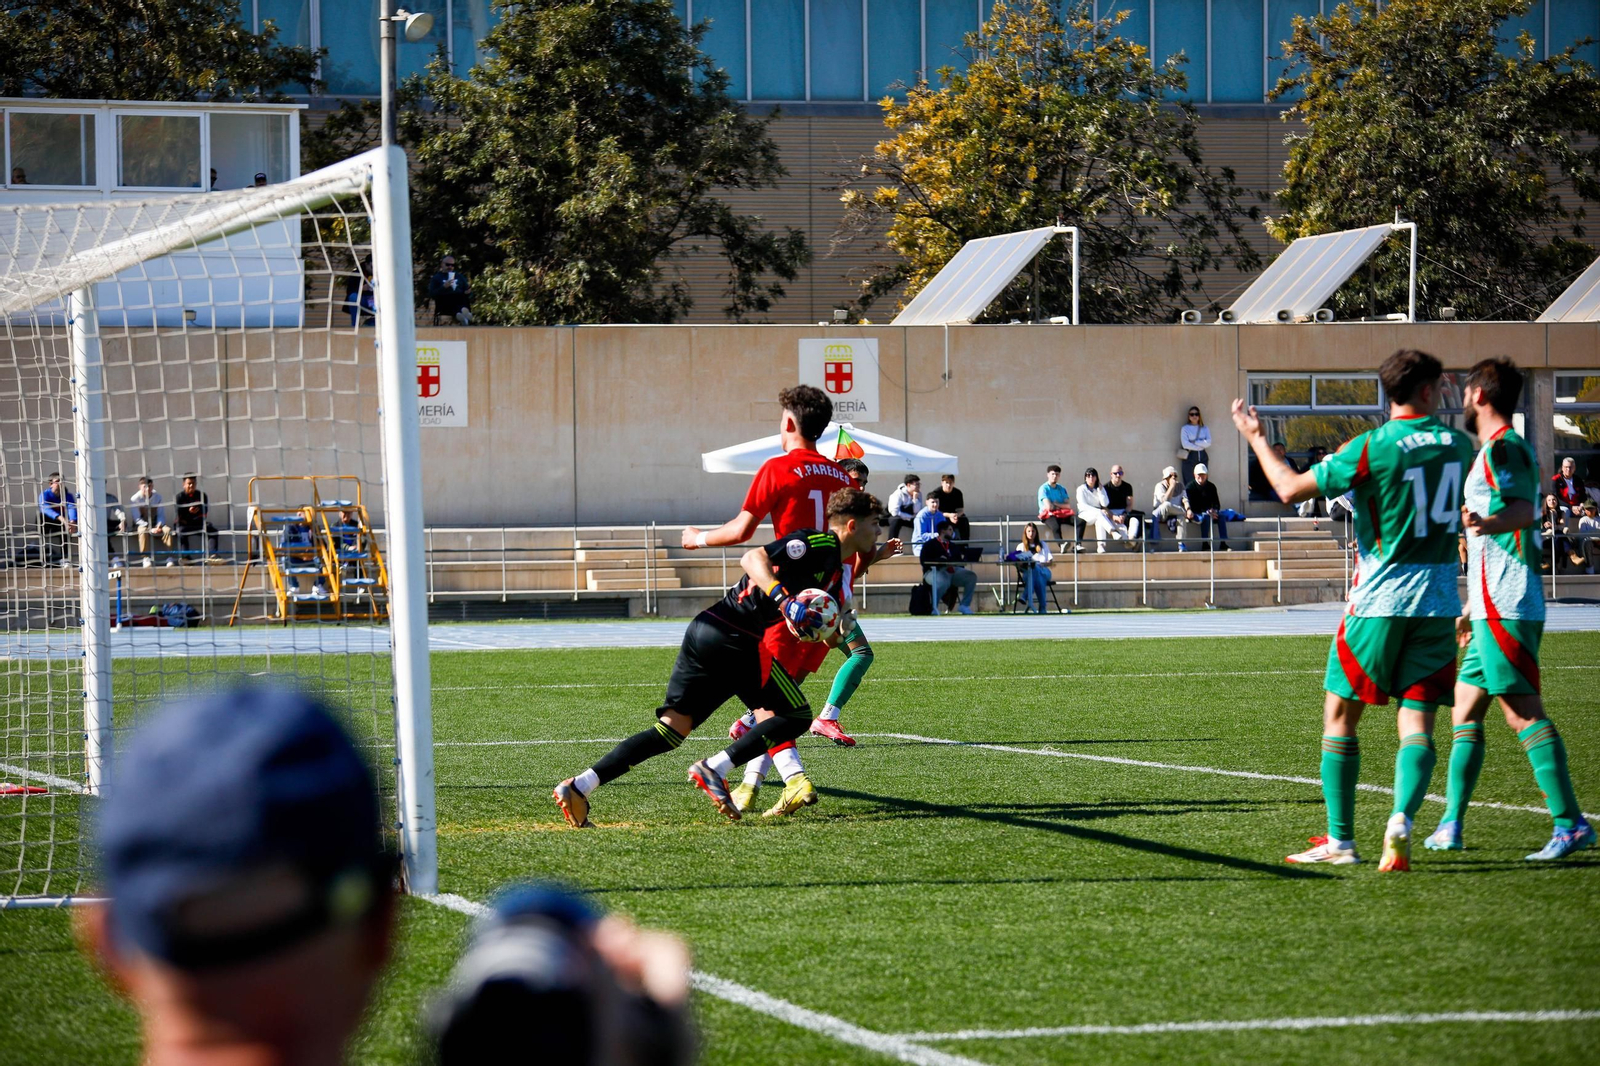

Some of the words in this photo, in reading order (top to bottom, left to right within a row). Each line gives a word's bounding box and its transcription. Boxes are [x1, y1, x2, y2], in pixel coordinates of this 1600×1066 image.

[418, 403, 455, 416] MERÍA
[832, 400, 867, 412] MERÍA
[832, 413, 854, 421] UDAD
[1402, 462, 1462, 538] 14
[807, 489, 824, 532] 1
